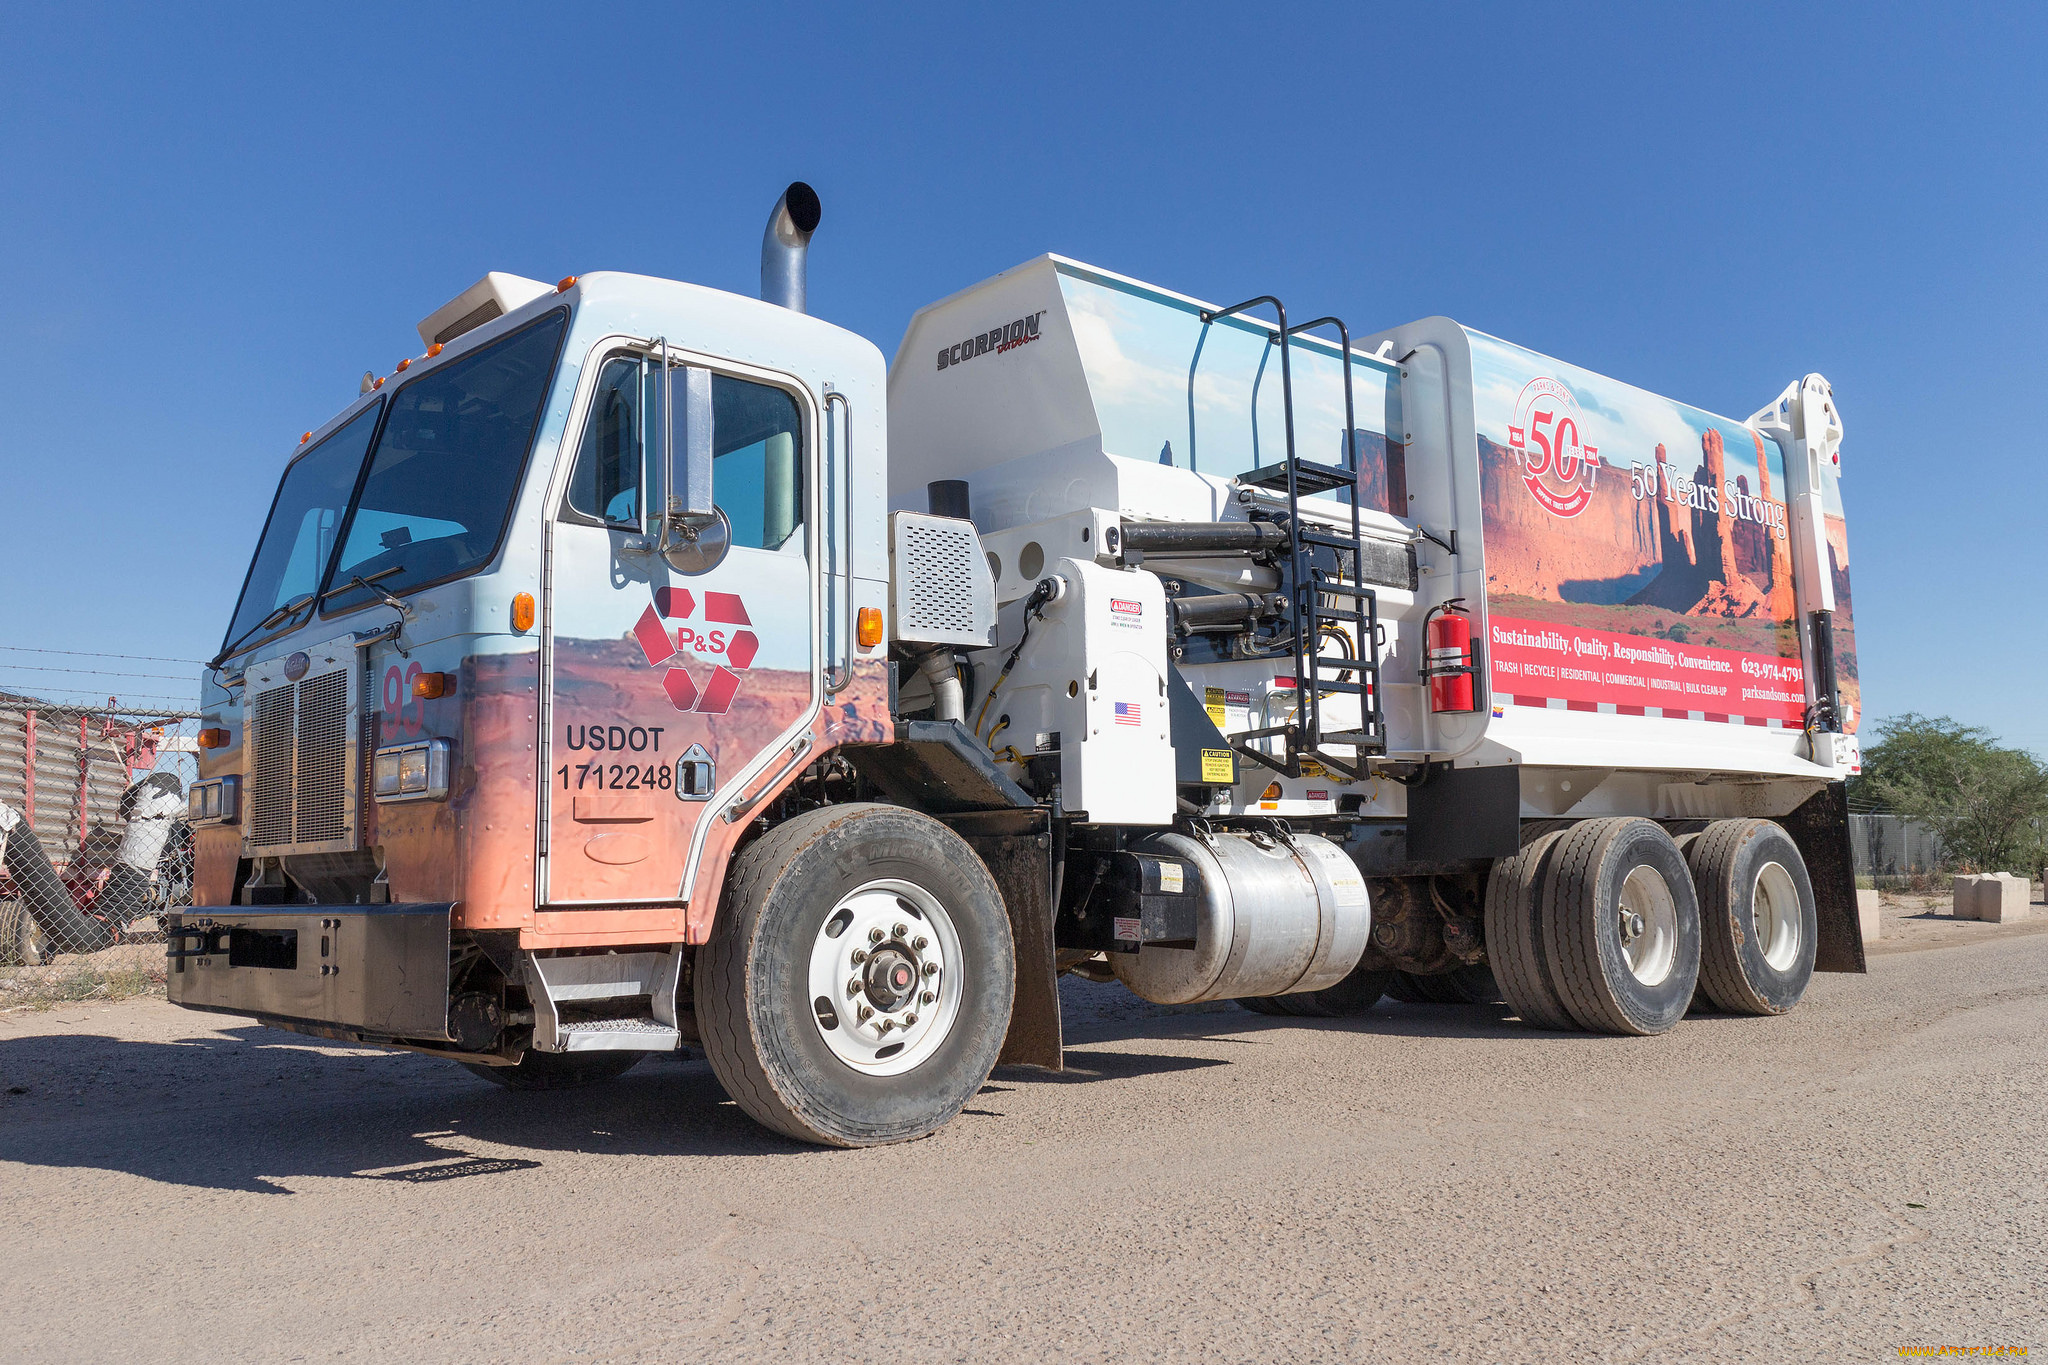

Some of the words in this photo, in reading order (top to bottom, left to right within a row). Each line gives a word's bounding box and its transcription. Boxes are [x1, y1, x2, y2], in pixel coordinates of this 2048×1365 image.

[1533, 381, 1550, 393] PARKS
[1551, 383, 1555, 392] &
[1556, 385, 1569, 403] SONS
[1527, 410, 1579, 481] 50
[1631, 459, 1658, 501] 50
[1659, 461, 1719, 513] Years
[1724, 480, 1786, 540] Strong
[1119, 601, 1140, 613] DANGER
[678, 627, 726, 653] P&S
[1492, 626, 1572, 655] Sustainability.
[1574, 636, 1611, 660] Quality.
[1613, 642, 1677, 669] Responsibility.
[1678, 652, 1733, 673] Convenience.
[1741, 657, 1803, 682] 623.974.4791
[1494, 660, 1518, 673] TRASH
[1524, 664, 1555, 677] RECYCLE
[1561, 668, 1601, 683] RESIDENTIAL
[1605, 673, 1646, 687] COMMERCIAL
[1650, 678, 1682, 692] INDUSTRIAL
[1686, 682, 1700, 694] BULK
[1701, 684, 1727, 696] CLEAN-UP
[383, 661, 424, 740] 93
[1742, 684, 1806, 703] parksandsons.com
[567, 724, 664, 752] USDOT
[557, 764, 672, 790] 1712248
